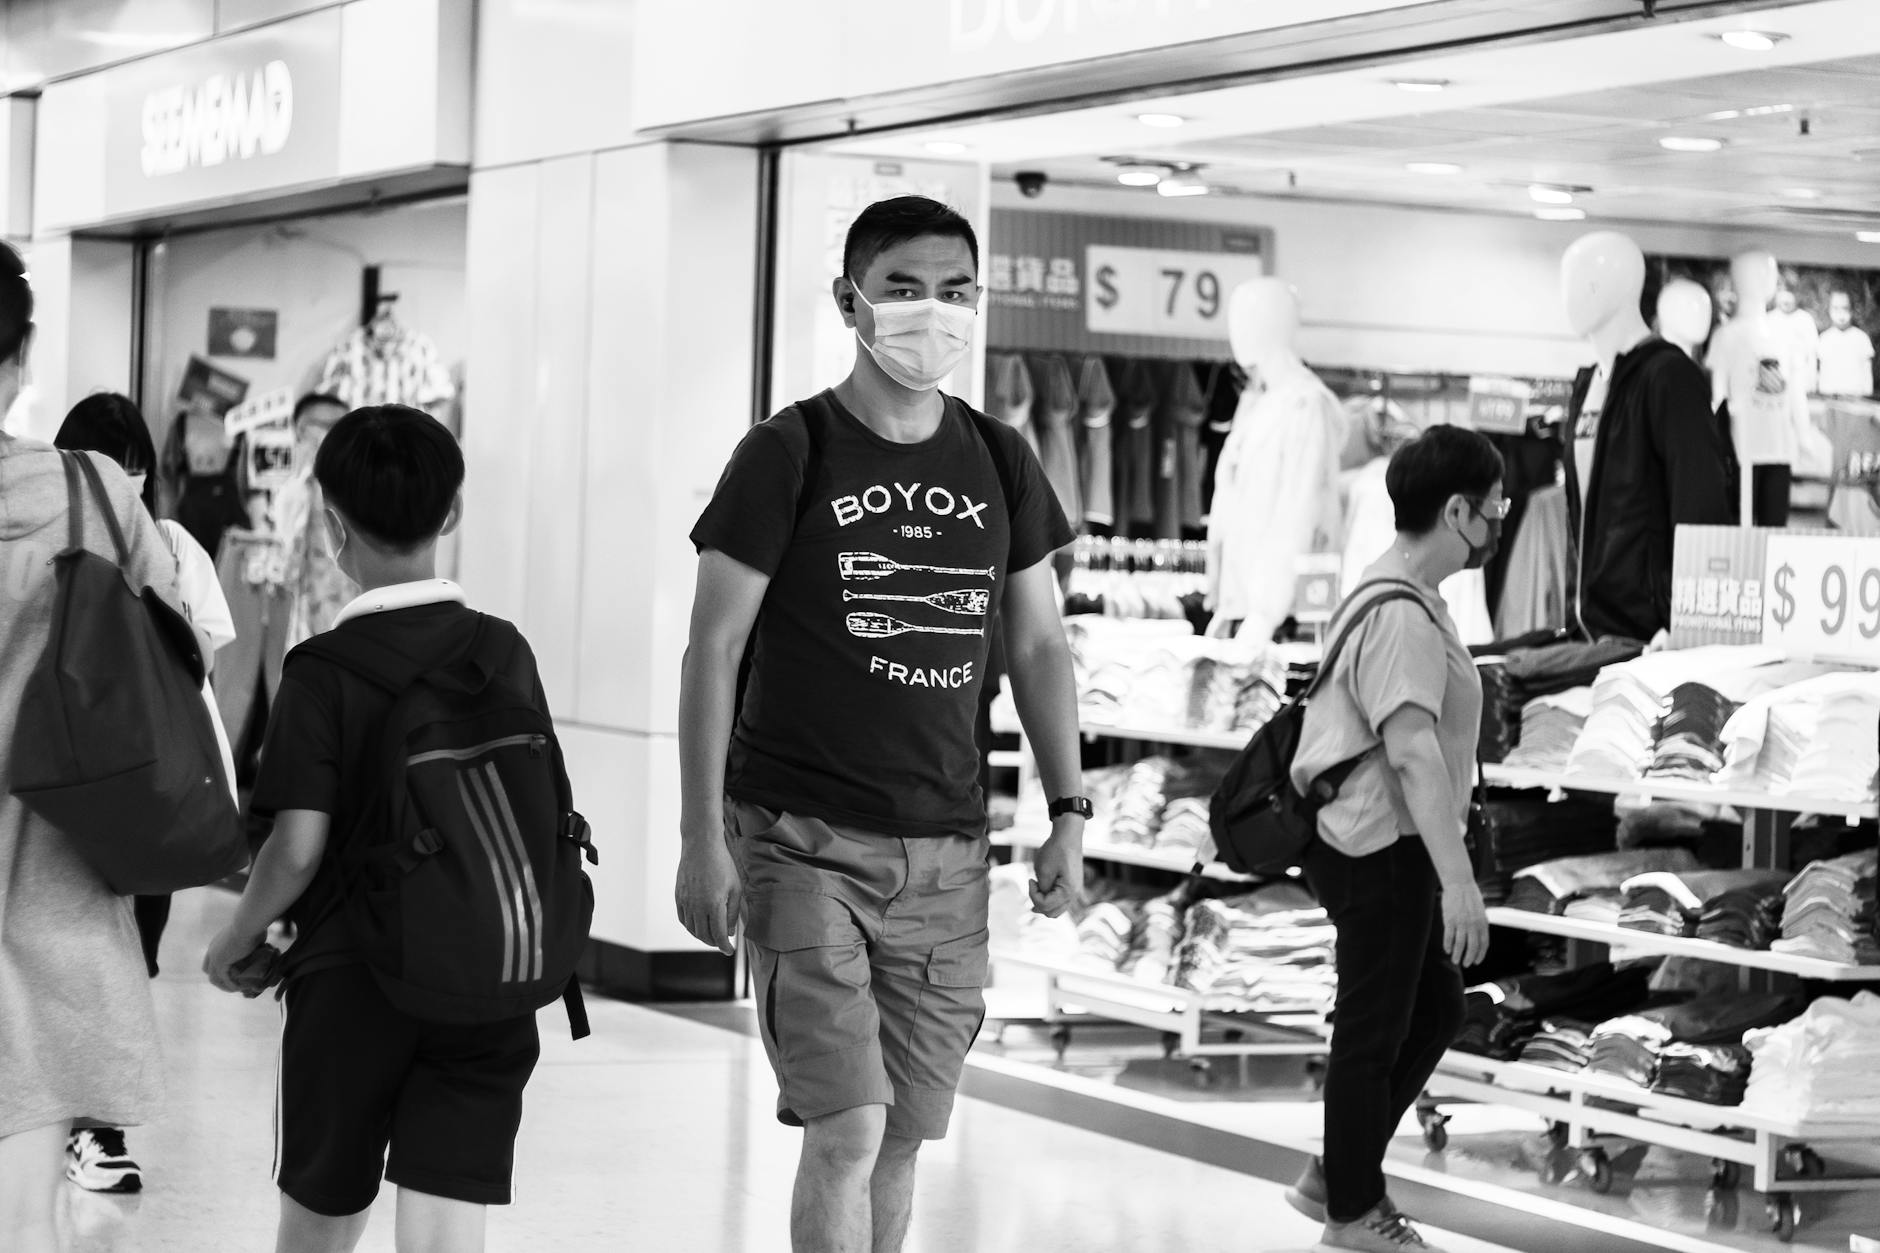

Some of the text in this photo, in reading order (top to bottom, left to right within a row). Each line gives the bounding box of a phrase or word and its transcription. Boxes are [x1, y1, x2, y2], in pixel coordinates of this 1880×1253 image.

[1096, 265, 1220, 319] $ 79
[831, 482, 988, 529] BOYOX
[1772, 561, 1880, 639] $ 99
[870, 656, 973, 688] FRANCE
